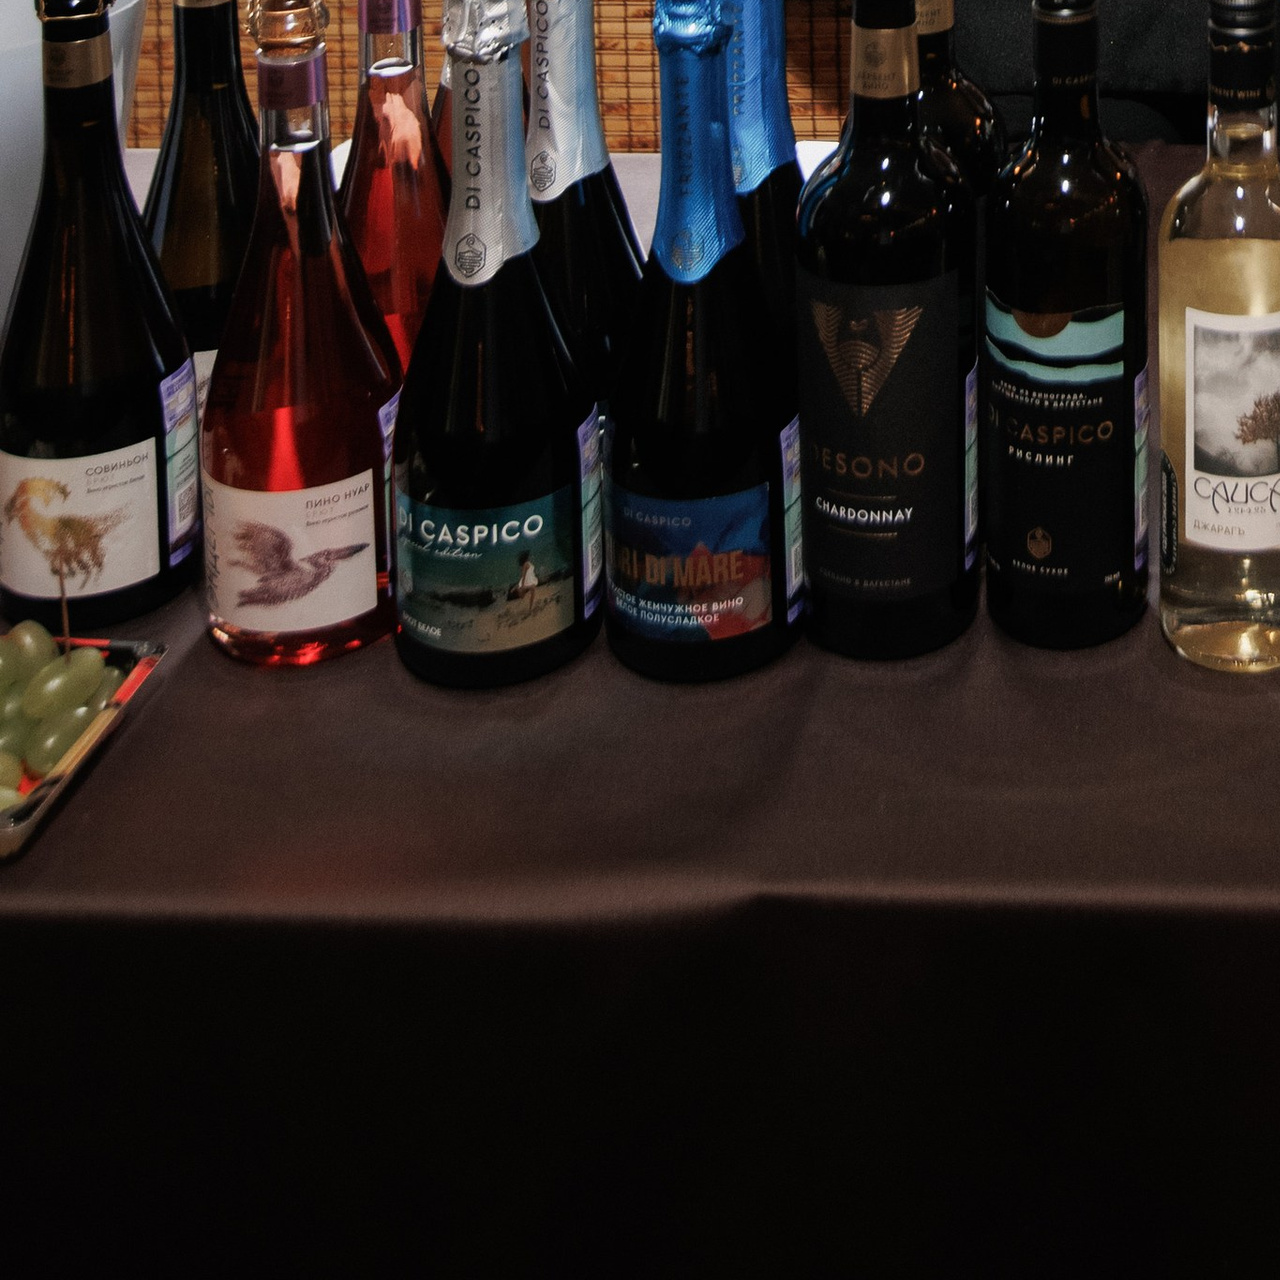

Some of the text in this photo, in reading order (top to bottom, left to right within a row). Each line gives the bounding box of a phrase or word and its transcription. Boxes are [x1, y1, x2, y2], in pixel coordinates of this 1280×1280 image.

[536, 0, 550, 129] DI CASPICO
[464, 66, 482, 210] DI CASPICO
[85, 451, 149, 477] СОВИНЬОН
[1008, 444, 1074, 467] РИСЛИНГ
[306, 481, 370, 509] ПИНО НУАР
[815, 495, 913, 523] CHARDONNAY
[623, 506, 692, 528] DI CASPICO
[420, 515, 545, 548] CASPICO
[645, 552, 667, 587] DI
[672, 549, 745, 590] MARE
[638, 597, 709, 614] ЖЕМЧУЖНОЕ
[711, 595, 745, 612] ВИНО
[640, 610, 721, 626] ПОЛУСЛАДКОЕ
